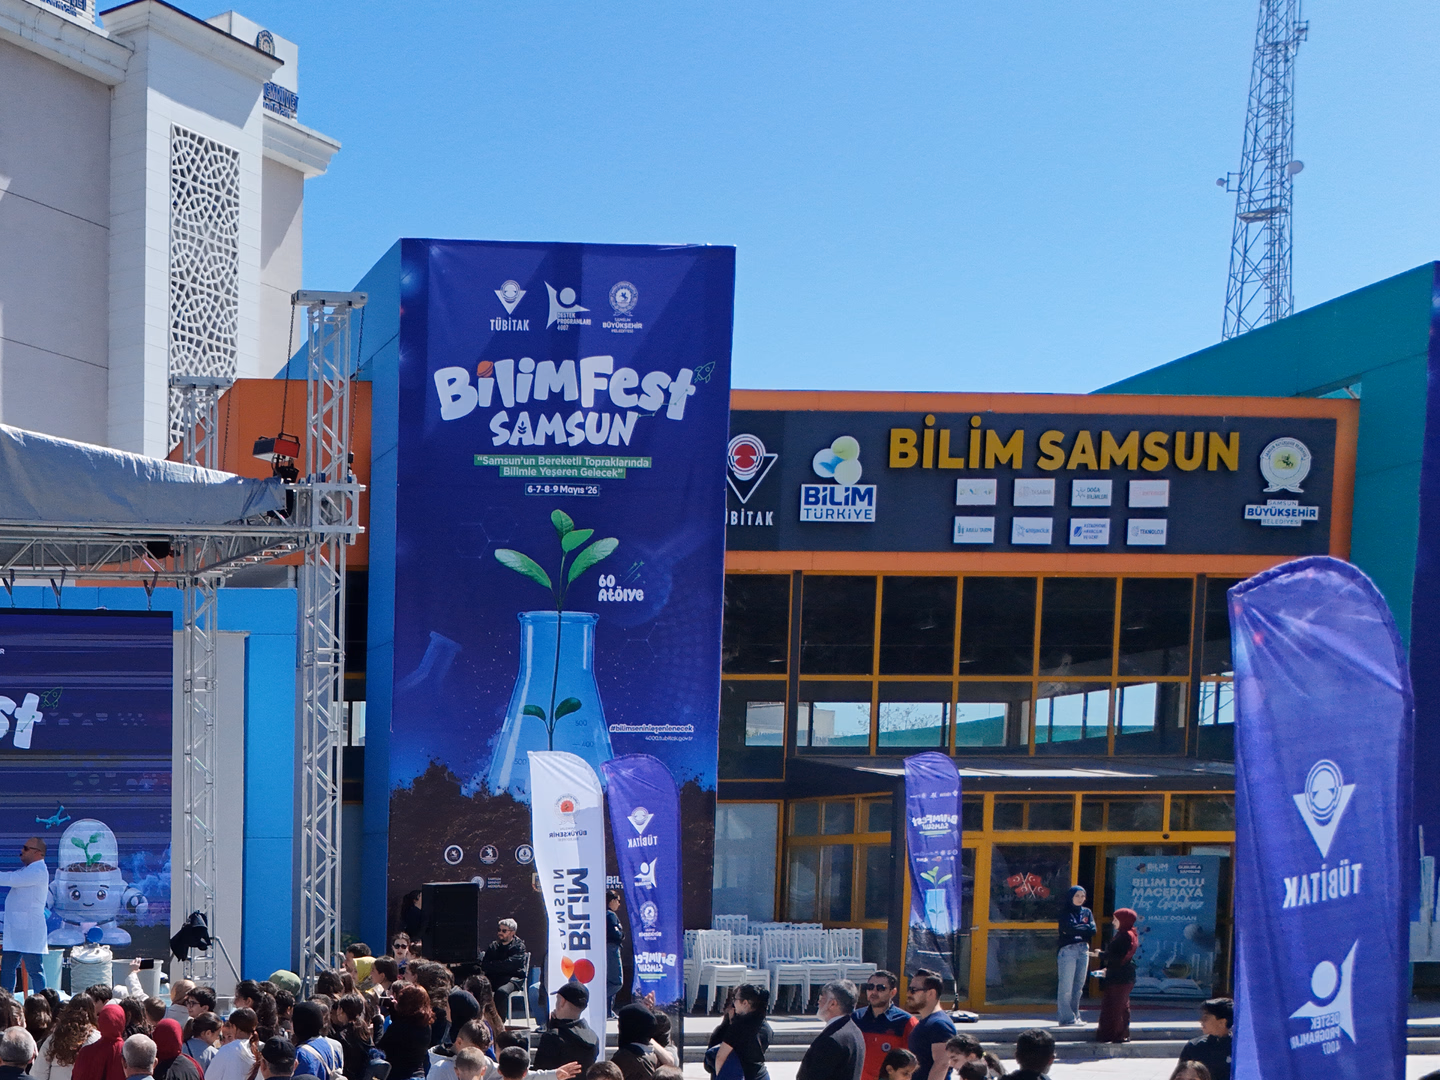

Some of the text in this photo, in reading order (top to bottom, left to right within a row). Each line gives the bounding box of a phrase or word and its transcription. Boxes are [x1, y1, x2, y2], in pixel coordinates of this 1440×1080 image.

[490, 317, 529, 331] TÜBİTAK
[602, 321, 643, 330] BÜYÜKŞEHİR
[489, 410, 639, 447] SAMSUN
[889, 414, 1240, 472] BİLİM SAMSUN
[538, 457, 582, 466] Bereketli
[584, 457, 649, 468] Topraklarında
[503, 467, 537, 476] Bilimle
[540, 467, 578, 478] Yeşeren
[527, 485, 559, 493] 6-7-8-9
[560, 485, 585, 495] Mayıs
[803, 508, 873, 520] TÜRKİYE
[1247, 506, 1316, 518] BÜYÜKŞEHİR
[598, 574, 615, 588] 60
[1132, 878, 1205, 887] BİLİM DOLU
[1131, 887, 1204, 898] MACERAYA
